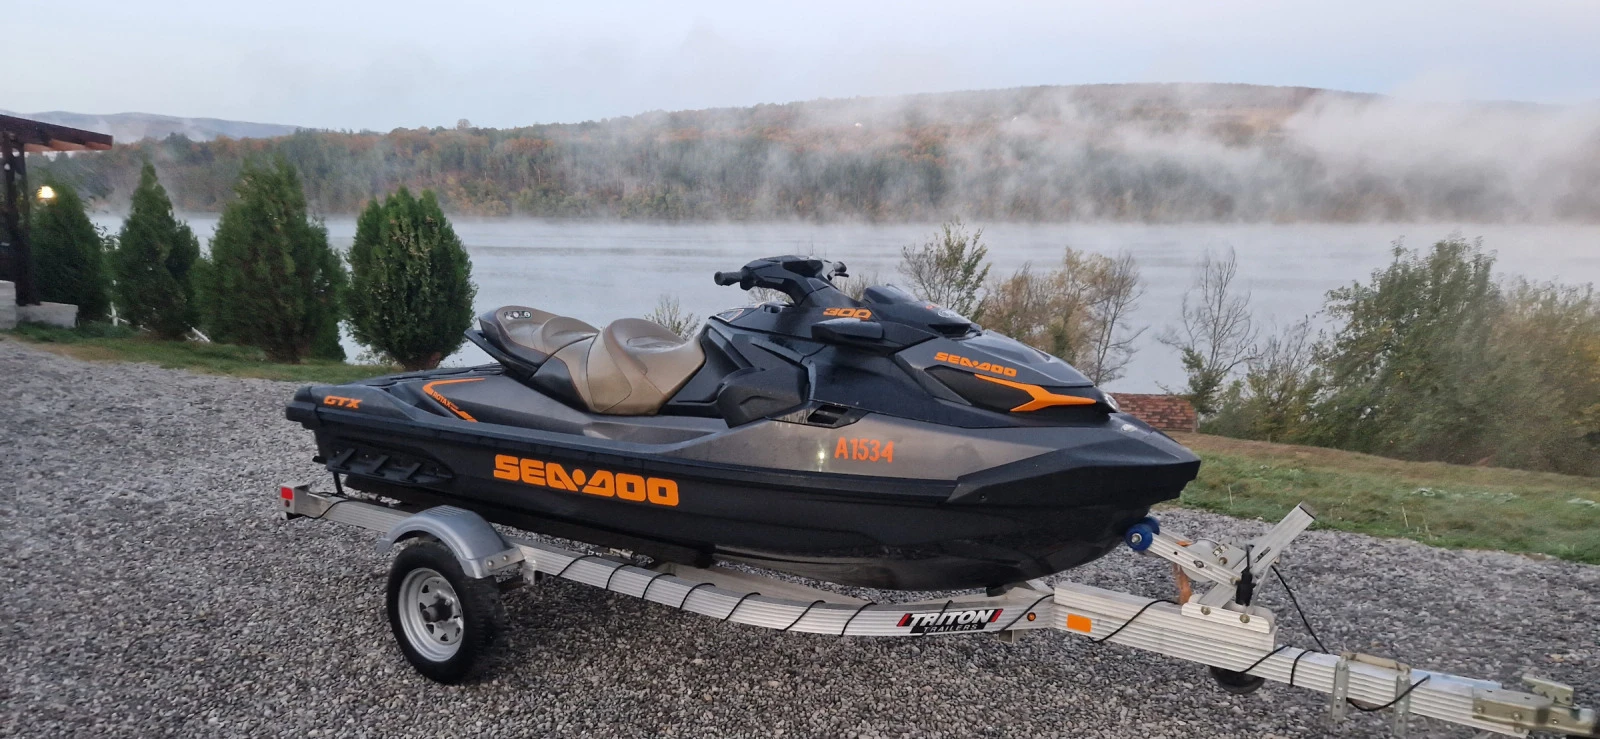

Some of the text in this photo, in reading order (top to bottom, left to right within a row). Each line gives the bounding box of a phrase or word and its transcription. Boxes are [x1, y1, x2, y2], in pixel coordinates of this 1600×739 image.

[823, 307, 873, 321] 300
[323, 395, 363, 409] GTX
[834, 437, 894, 463] A1534
[909, 610, 994, 627] TRITON
[923, 624, 978, 633] TRAILERS
